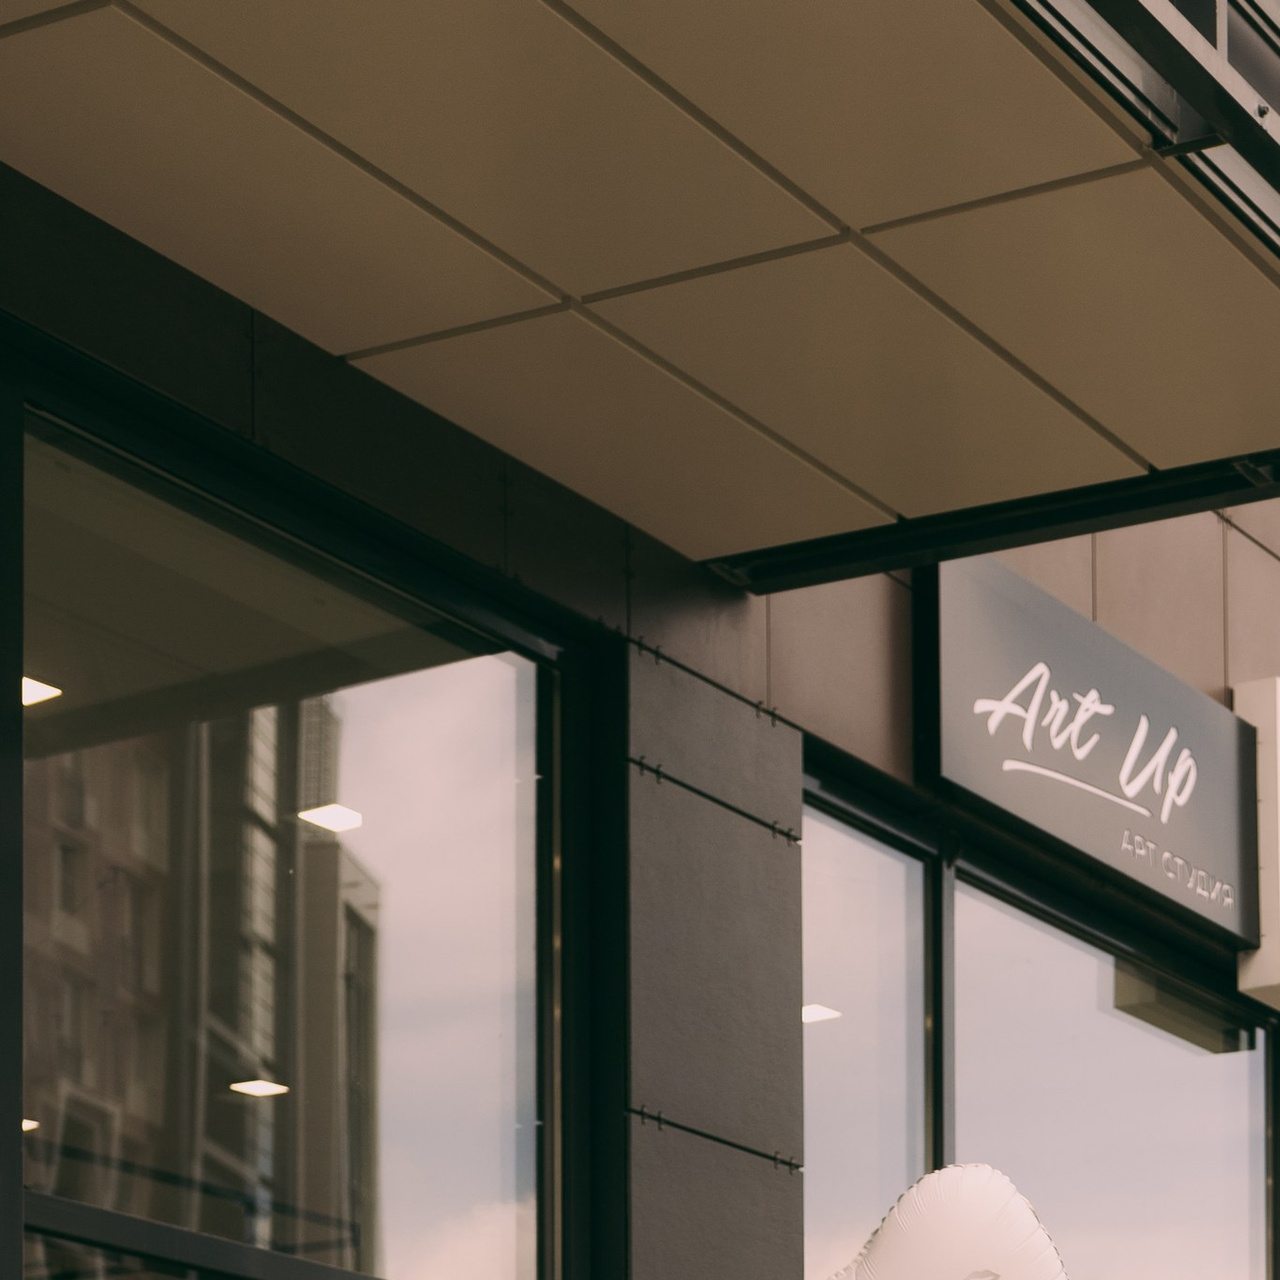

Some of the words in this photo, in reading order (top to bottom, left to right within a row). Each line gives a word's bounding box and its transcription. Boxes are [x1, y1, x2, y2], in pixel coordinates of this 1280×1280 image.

[973, 661, 1115, 761] Art
[1118, 714, 1199, 825] Up
[1121, 829, 1157, 868] АРТ
[1161, 850, 1236, 910] СТУДИЯ
